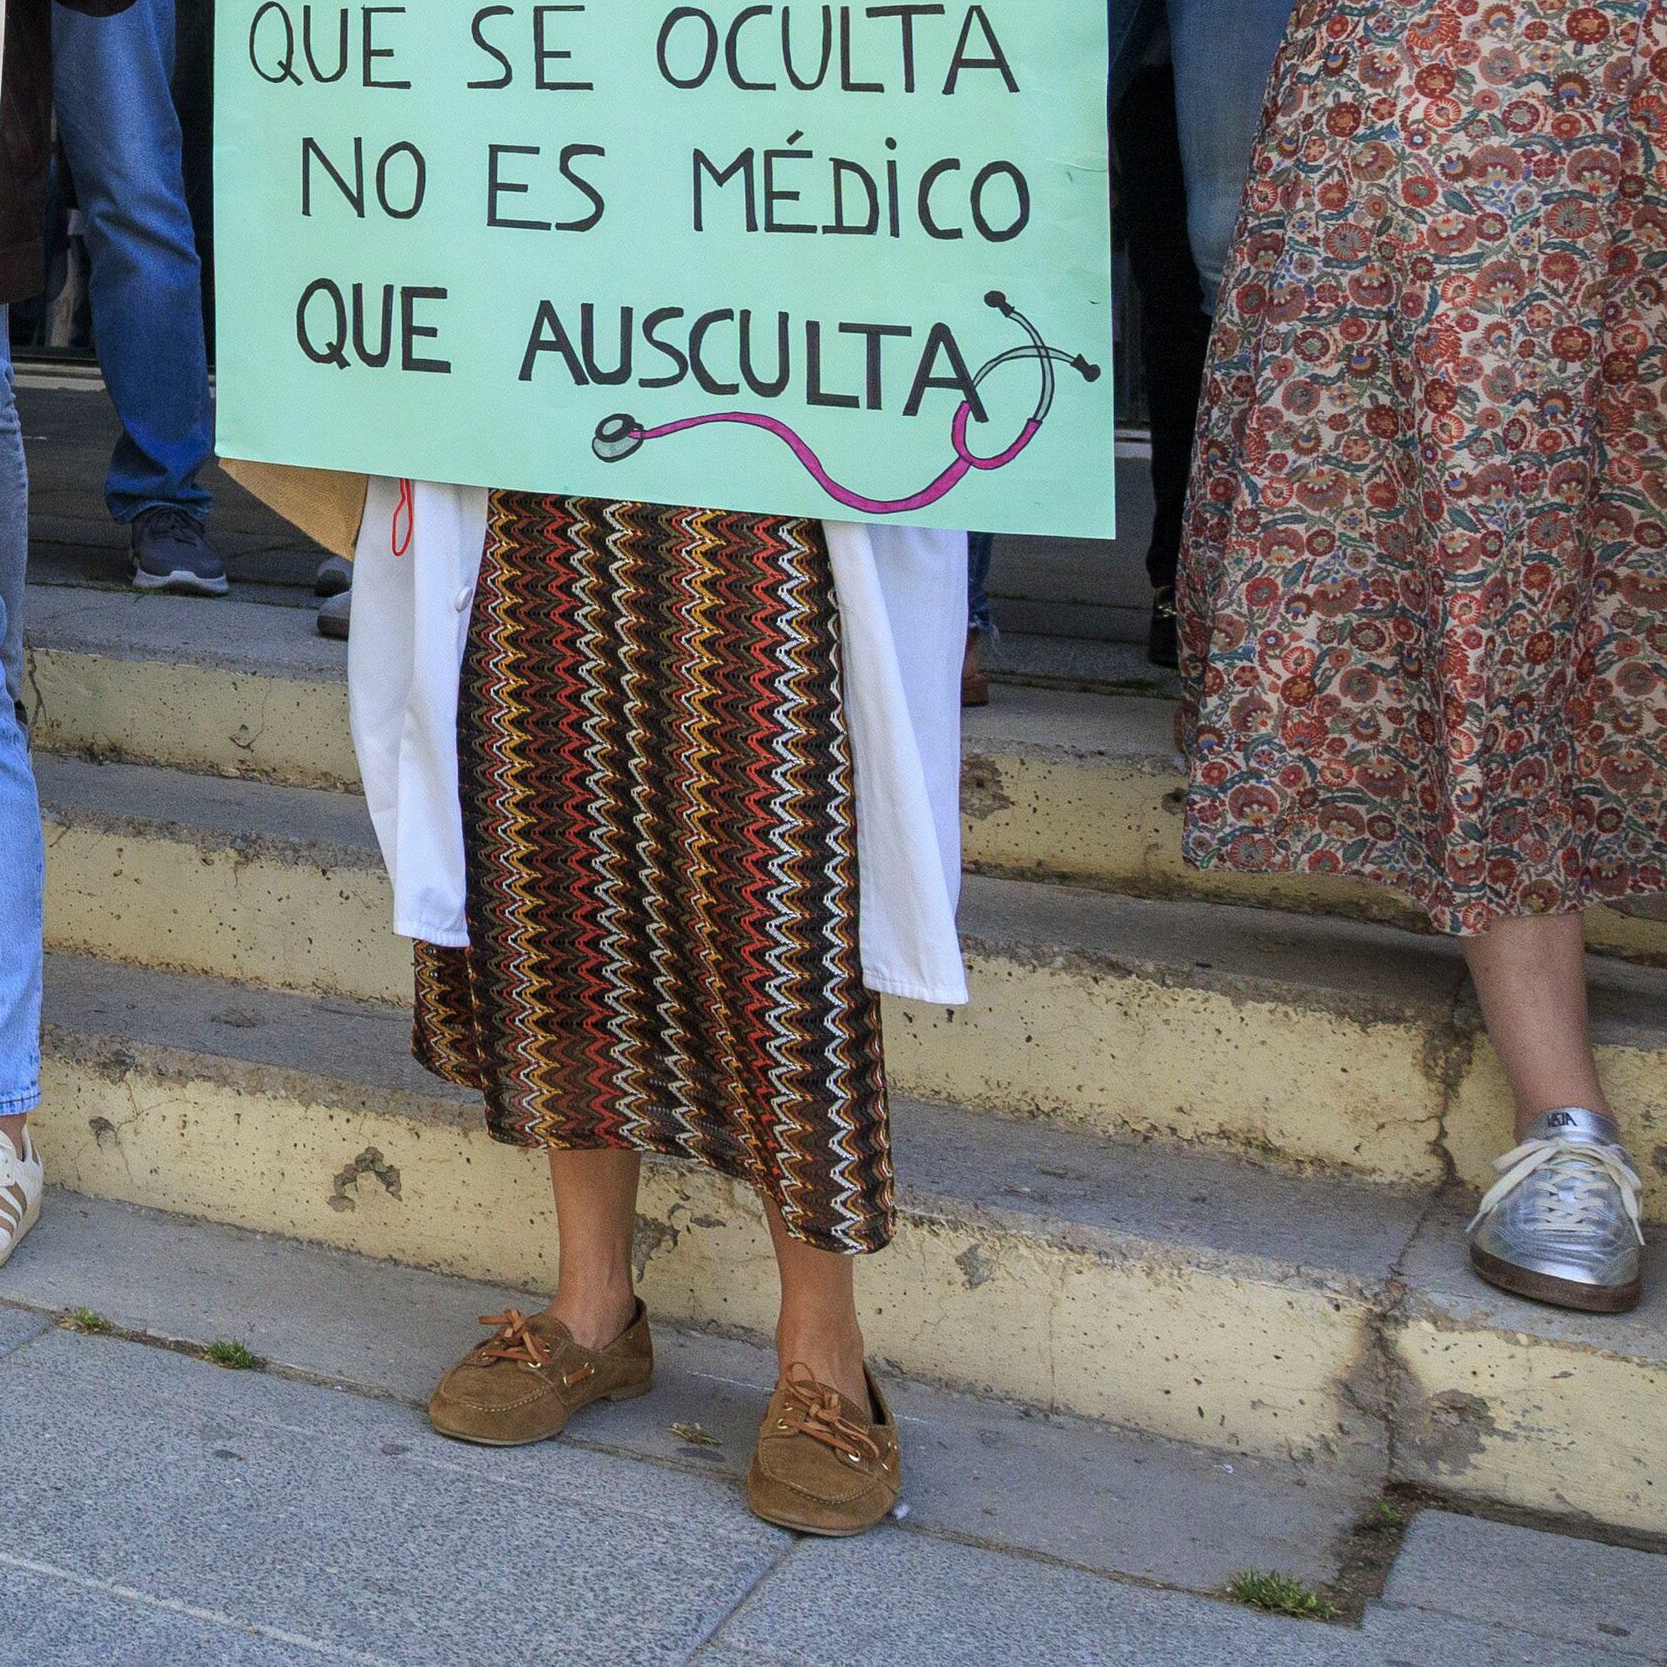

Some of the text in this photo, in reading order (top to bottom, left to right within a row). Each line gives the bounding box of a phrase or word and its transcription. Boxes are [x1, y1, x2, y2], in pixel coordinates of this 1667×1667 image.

[249, 1, 1021, 96] QUE SE OCULTA
[301, 135, 427, 220] NO
[486, 143, 607, 233] ES
[296, 276, 990, 422] QUE AUSCULTA
